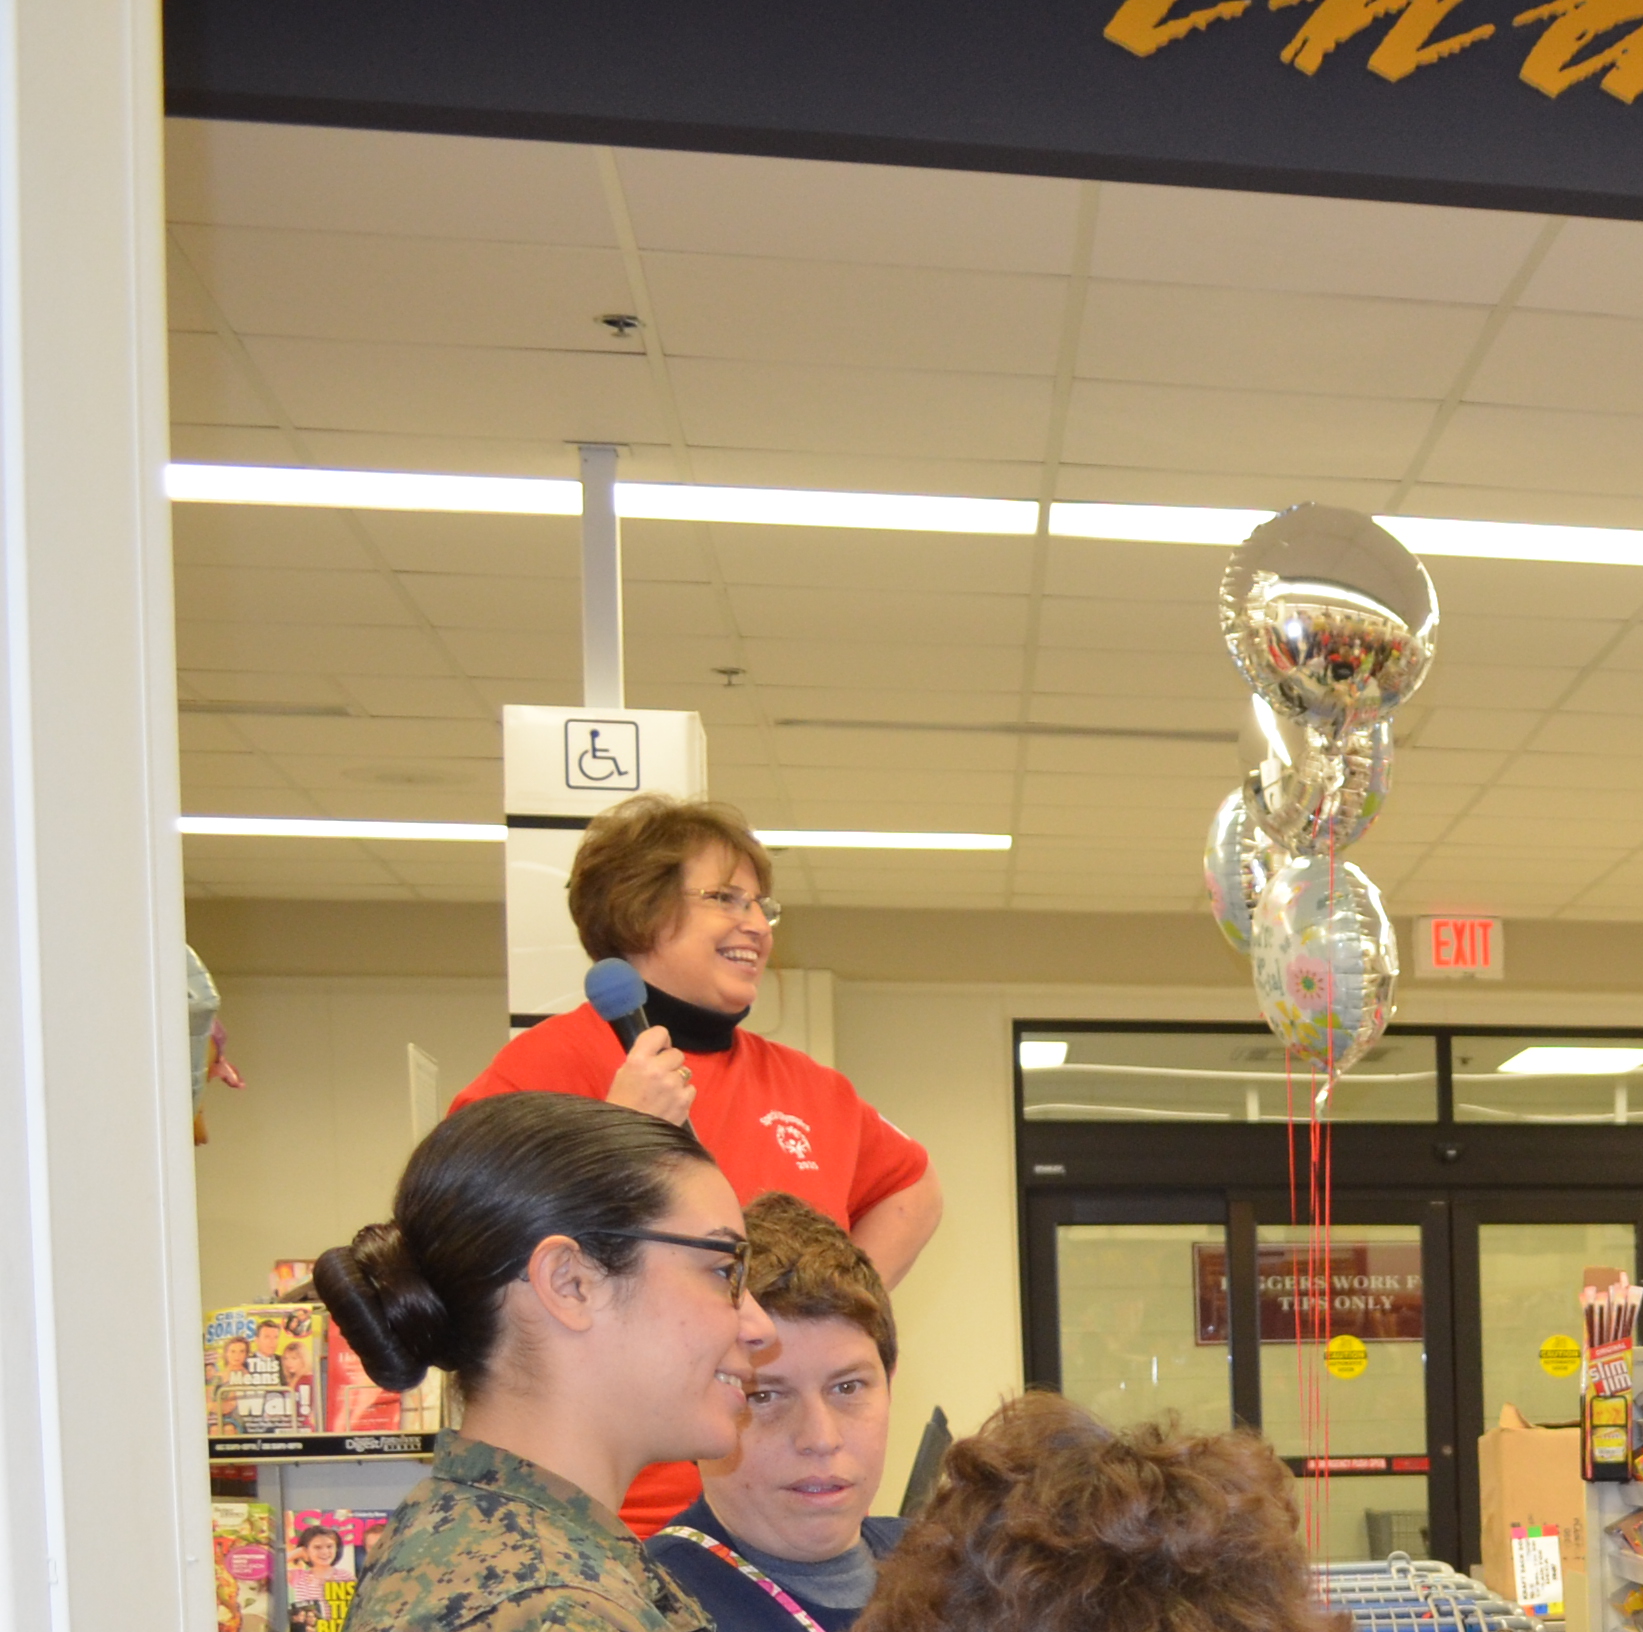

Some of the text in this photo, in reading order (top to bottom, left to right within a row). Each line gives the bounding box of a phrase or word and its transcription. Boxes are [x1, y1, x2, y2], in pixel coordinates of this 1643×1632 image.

[1431, 919, 1494, 968] EXIT
[1332, 1275, 1399, 1290] WORK
[1278, 1296, 1395, 1311] TIPS ONLY
[215, 1311, 246, 1322] CBS
[206, 1318, 258, 1344] SOAPS
[1595, 1341, 1627, 1357] ORIGINAL
[247, 1357, 280, 1373] This
[229, 1370, 280, 1386] Means
[289, 1509, 389, 1546] Star
